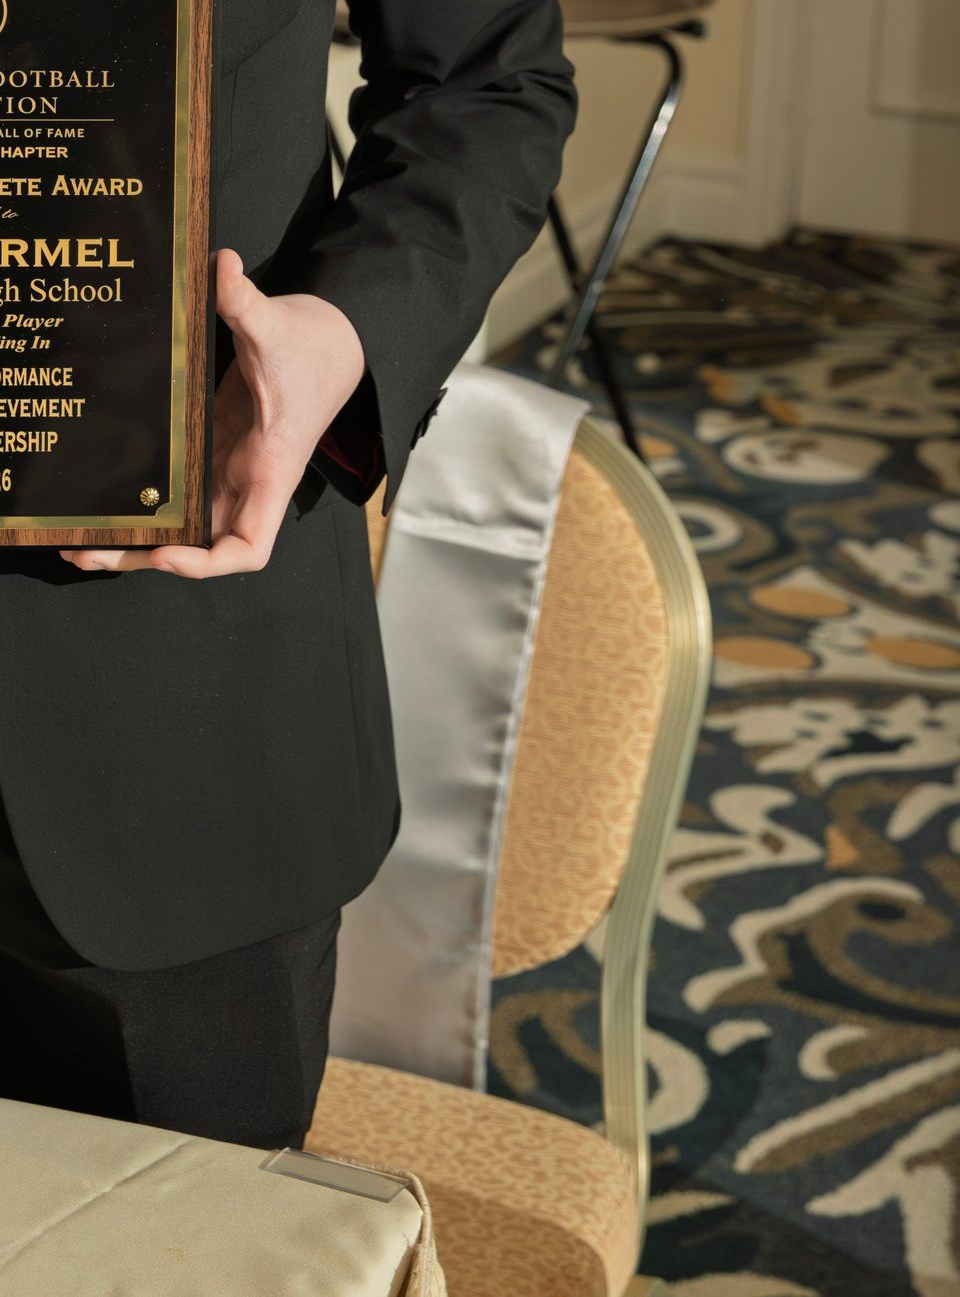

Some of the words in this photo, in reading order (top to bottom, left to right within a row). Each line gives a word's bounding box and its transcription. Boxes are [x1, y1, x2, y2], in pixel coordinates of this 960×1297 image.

[23, 128, 43, 139] OF
[47, 127, 85, 139] FAME
[51, 174, 144, 196] AWARD
[1, 209, 19, 219] to
[30, 277, 123, 303] School
[1, 313, 65, 332] Player
[30, 335, 51, 350] In
